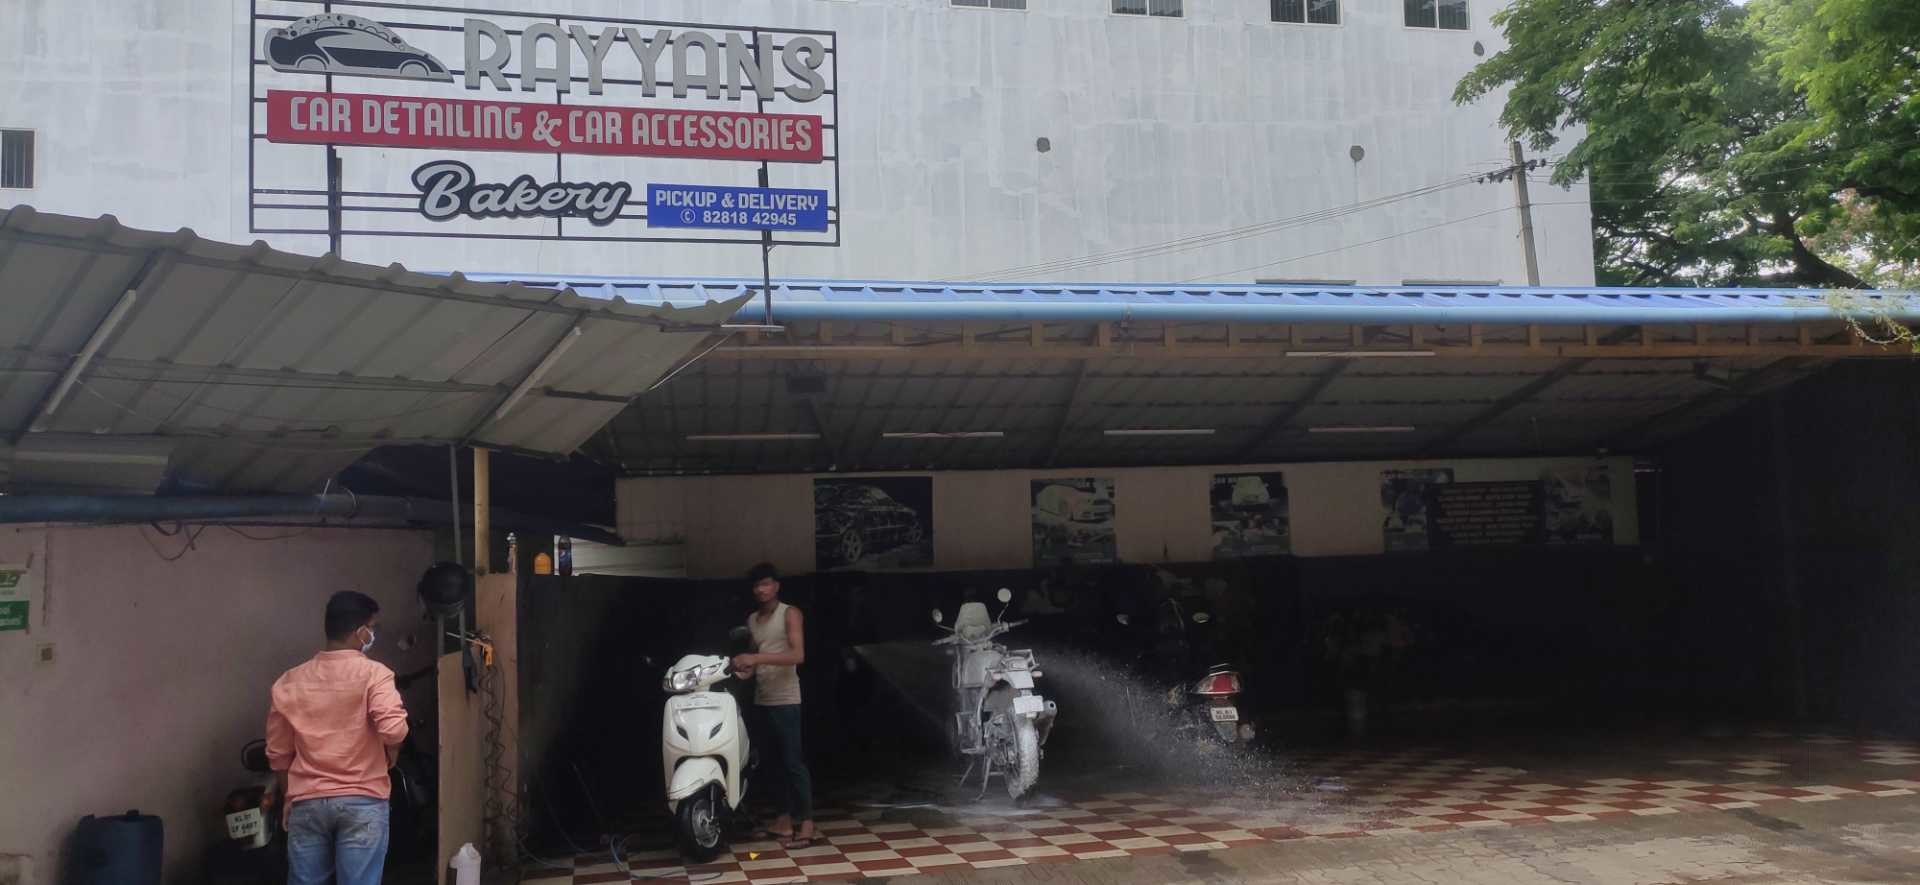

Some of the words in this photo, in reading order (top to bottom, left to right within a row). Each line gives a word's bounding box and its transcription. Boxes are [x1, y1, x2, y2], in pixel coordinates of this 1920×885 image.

[464, 18, 826, 103] RAYYANS
[290, 97, 351, 133] CAR
[362, 99, 523, 140] DETAILING
[532, 110, 562, 147] &
[568, 111, 623, 147] CAR
[632, 113, 813, 151] ACCESSORIES
[413, 161, 629, 223] Bakery
[655, 189, 717, 208] PICKUP
[721, 192, 735, 208] &
[738, 193, 818, 211] DELIVERY
[703, 210, 748, 225] 82818
[752, 212, 797, 226] 42945
